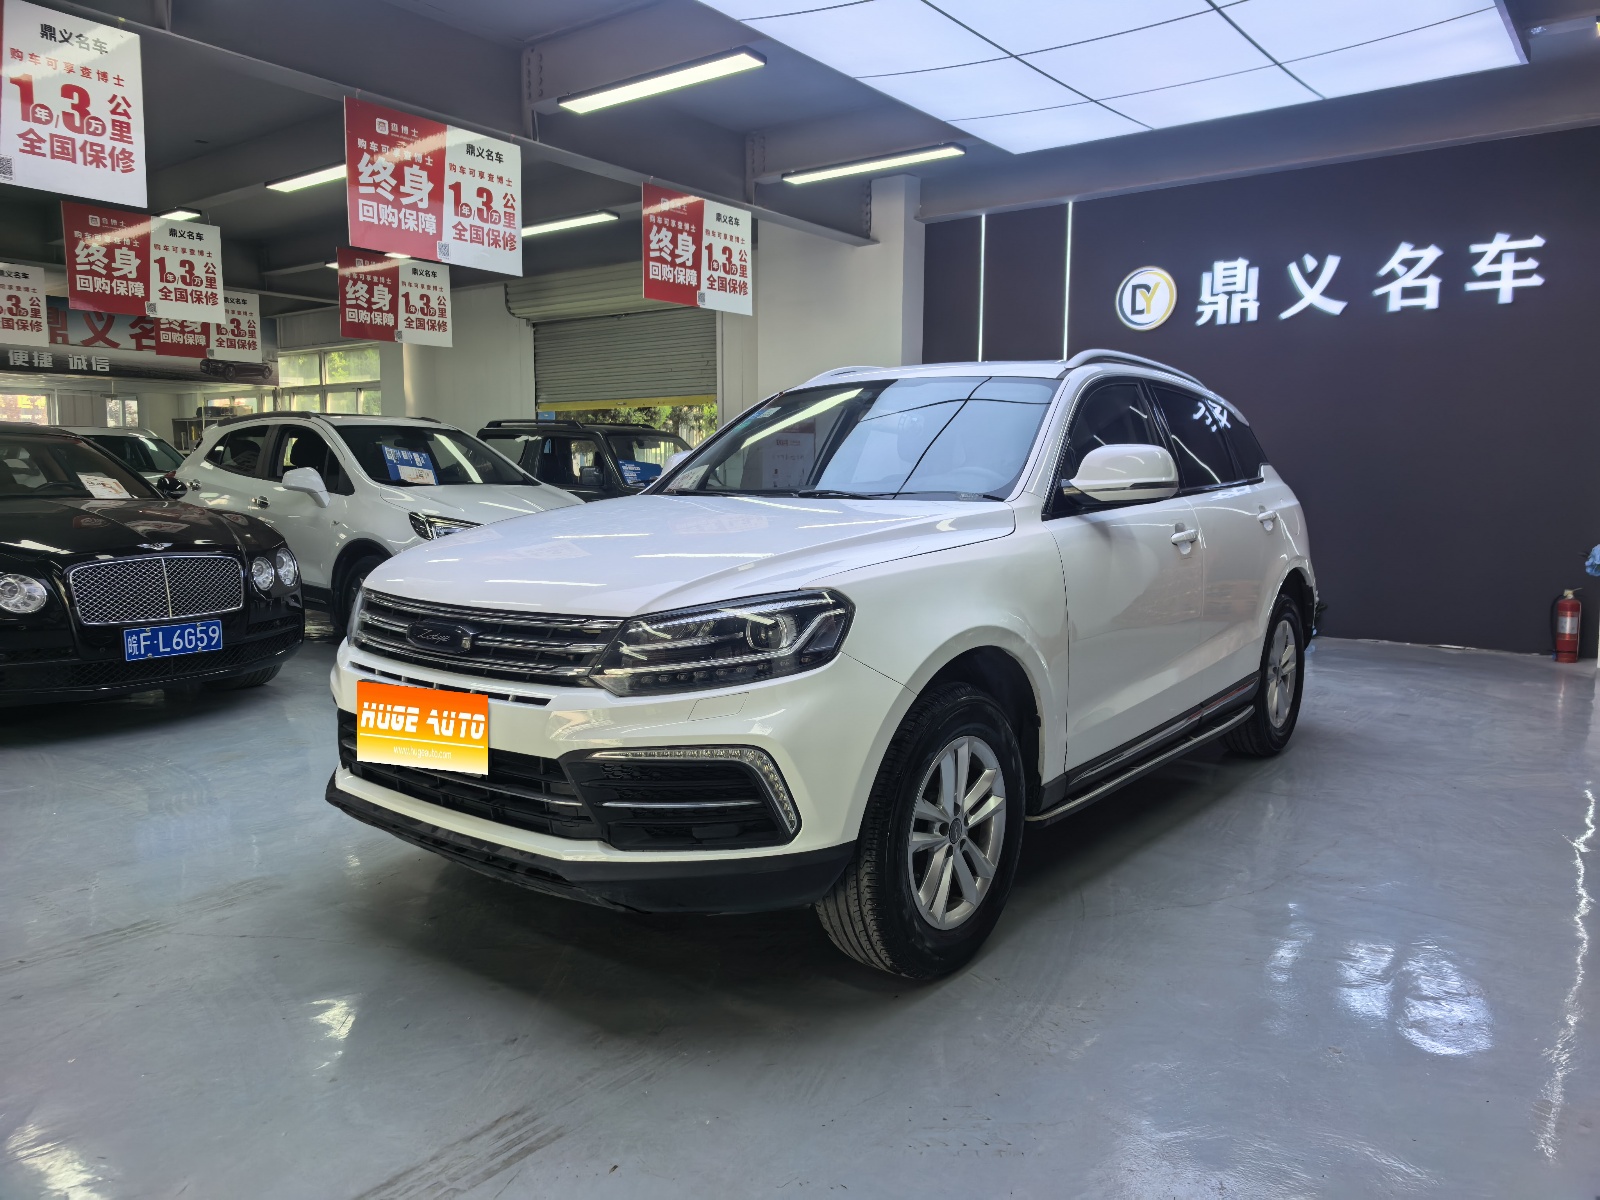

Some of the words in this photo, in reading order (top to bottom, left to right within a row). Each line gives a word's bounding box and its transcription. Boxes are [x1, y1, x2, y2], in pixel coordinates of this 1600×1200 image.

[40, 23, 109, 55] 鼎义名车
[9, 47, 125, 88] 购车可享查博士
[16, 127, 136, 174] 全国保修
[466, 143, 504, 164] 鼎义名车
[357, 152, 434, 209] 终身
[358, 199, 437, 236] 回购保障
[169, 228, 205, 241] 鼎义名车
[452, 221, 517, 252] 全国保修
[649, 224, 697, 267] 终身
[74, 240, 141, 279] 终身
[76, 274, 145, 298] 回购保障
[649, 261, 698, 287] 回购保障
[707, 274, 748, 296] 全国保修
[1195, 232, 1546, 327] 鼎义名车
[158, 286, 219, 306] 全国保修
[345, 280, 392, 311] 终身
[0, 317, 43, 332] 国保修
[346, 307, 395, 327] 回购保障
[404, 316, 448, 333] 全国保修
[160, 331, 206, 347] 回购保障
[215, 337, 257, 350] 全国保修
[8, 349, 53, 368] 便捷
[68, 354, 110, 372] 诚信
